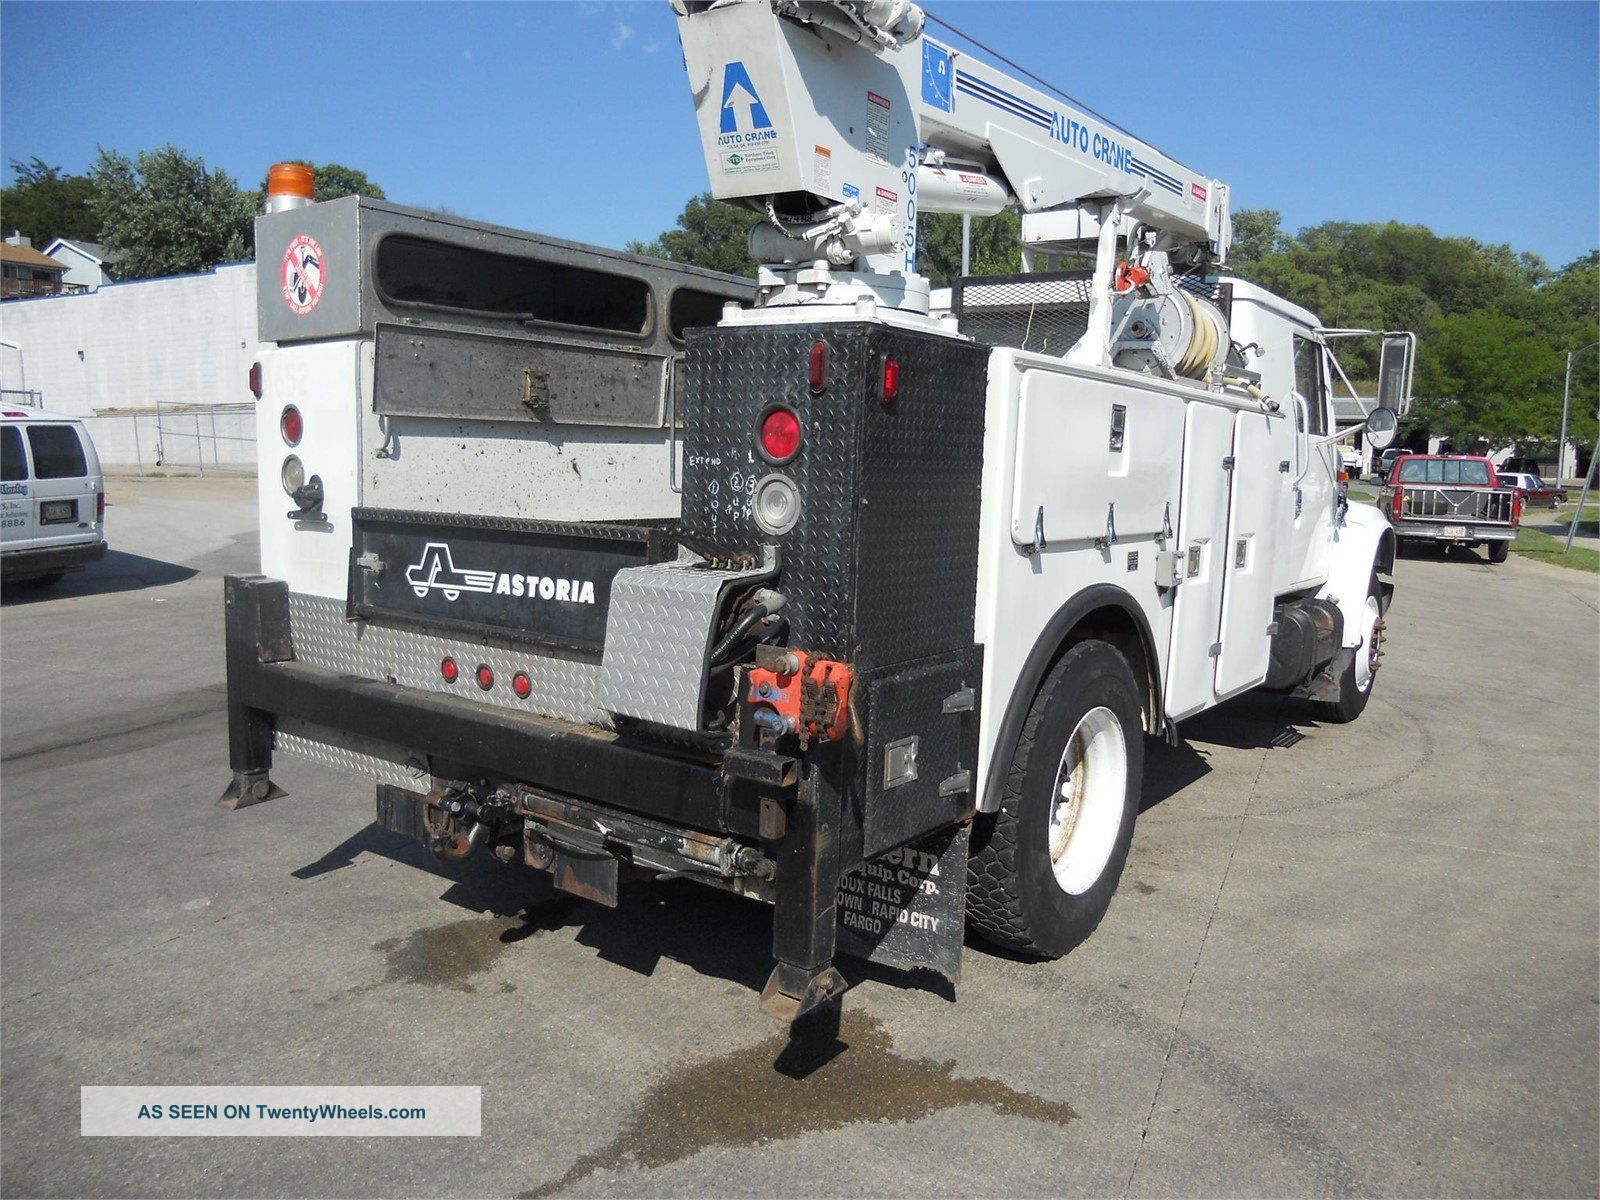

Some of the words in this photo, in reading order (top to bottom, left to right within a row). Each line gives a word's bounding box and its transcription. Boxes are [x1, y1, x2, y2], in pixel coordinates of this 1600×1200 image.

[718, 134, 743, 146] AUTO
[745, 130, 777, 142] CRANE
[1050, 111, 1089, 154] AUTO
[1092, 133, 1132, 174] CRANE
[496, 573, 596, 604] ASTORIA
[867, 882, 901, 904] FALLS
[896, 869, 940, 895] Corp.
[843, 910, 881, 934] FARGO
[872, 901, 909, 924] RAPID
[910, 911, 940, 932] CITY
